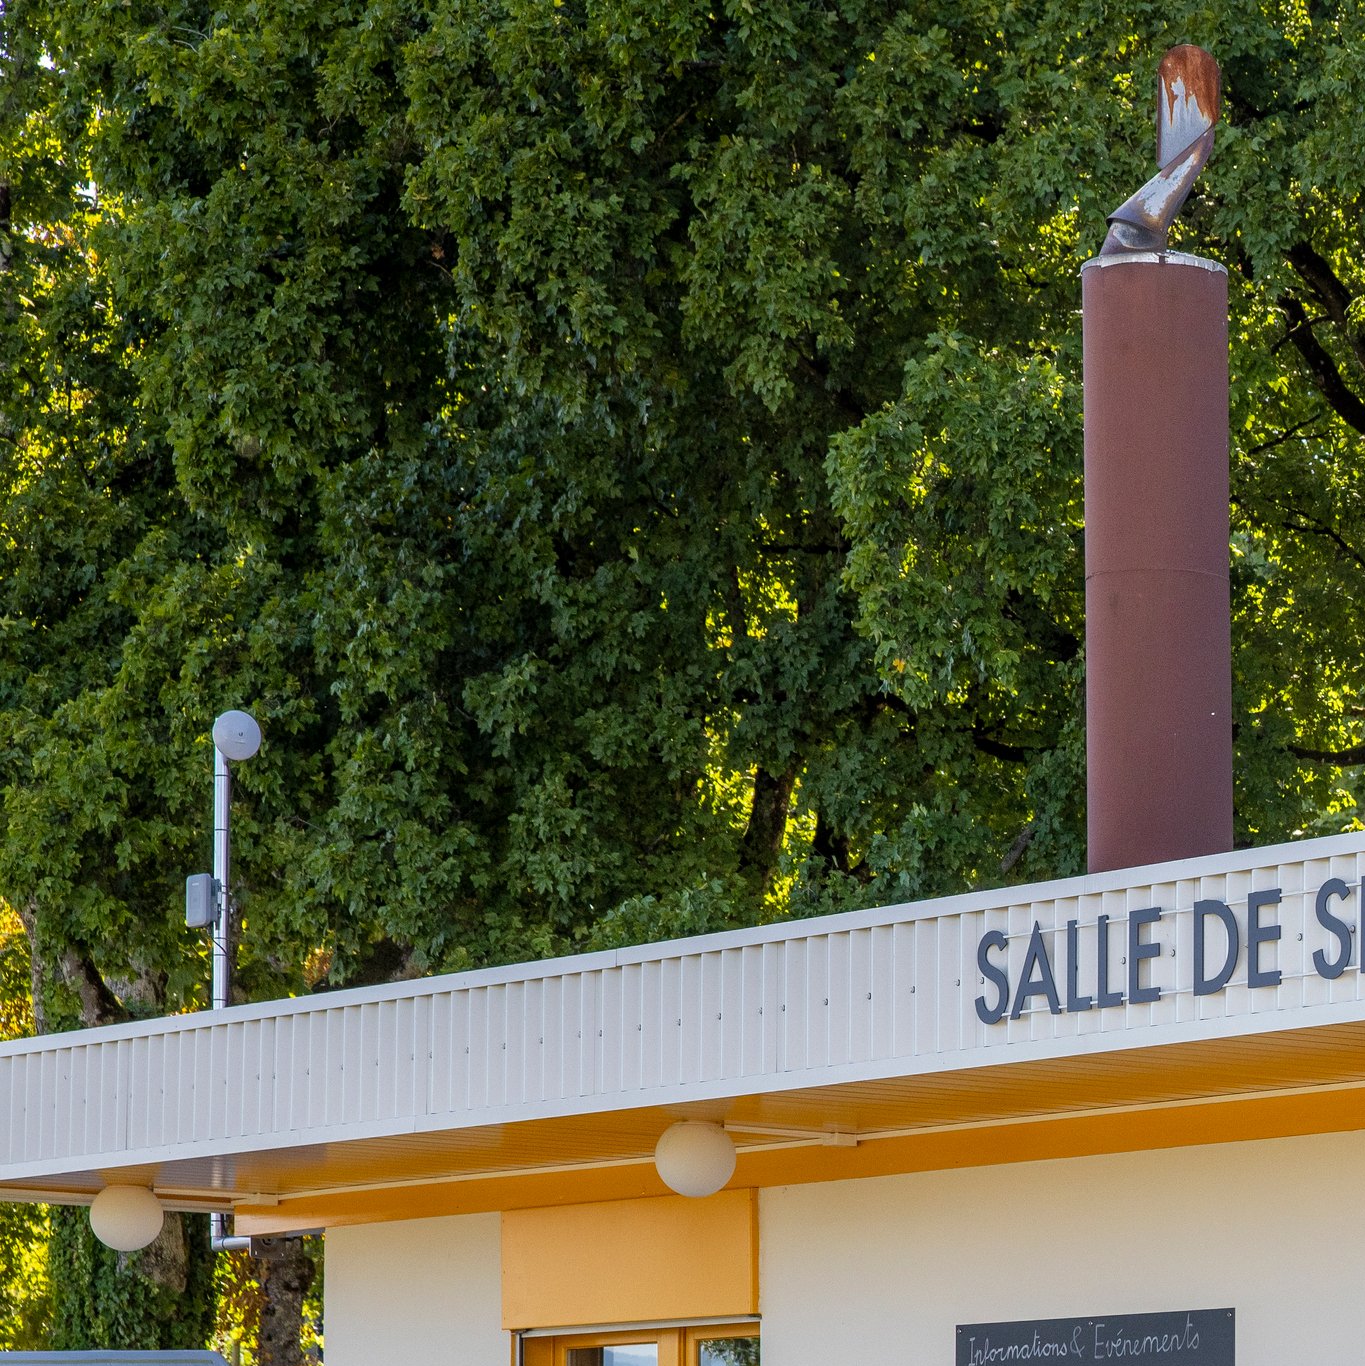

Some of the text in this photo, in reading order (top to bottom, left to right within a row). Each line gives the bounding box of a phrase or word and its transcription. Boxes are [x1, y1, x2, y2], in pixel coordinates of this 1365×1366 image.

[974, 906, 1162, 1025] SALLE
[1193, 888, 1282, 997] DE
[1069, 1325, 1085, 1358] &
[1094, 1313, 1199, 1359] Evénements
